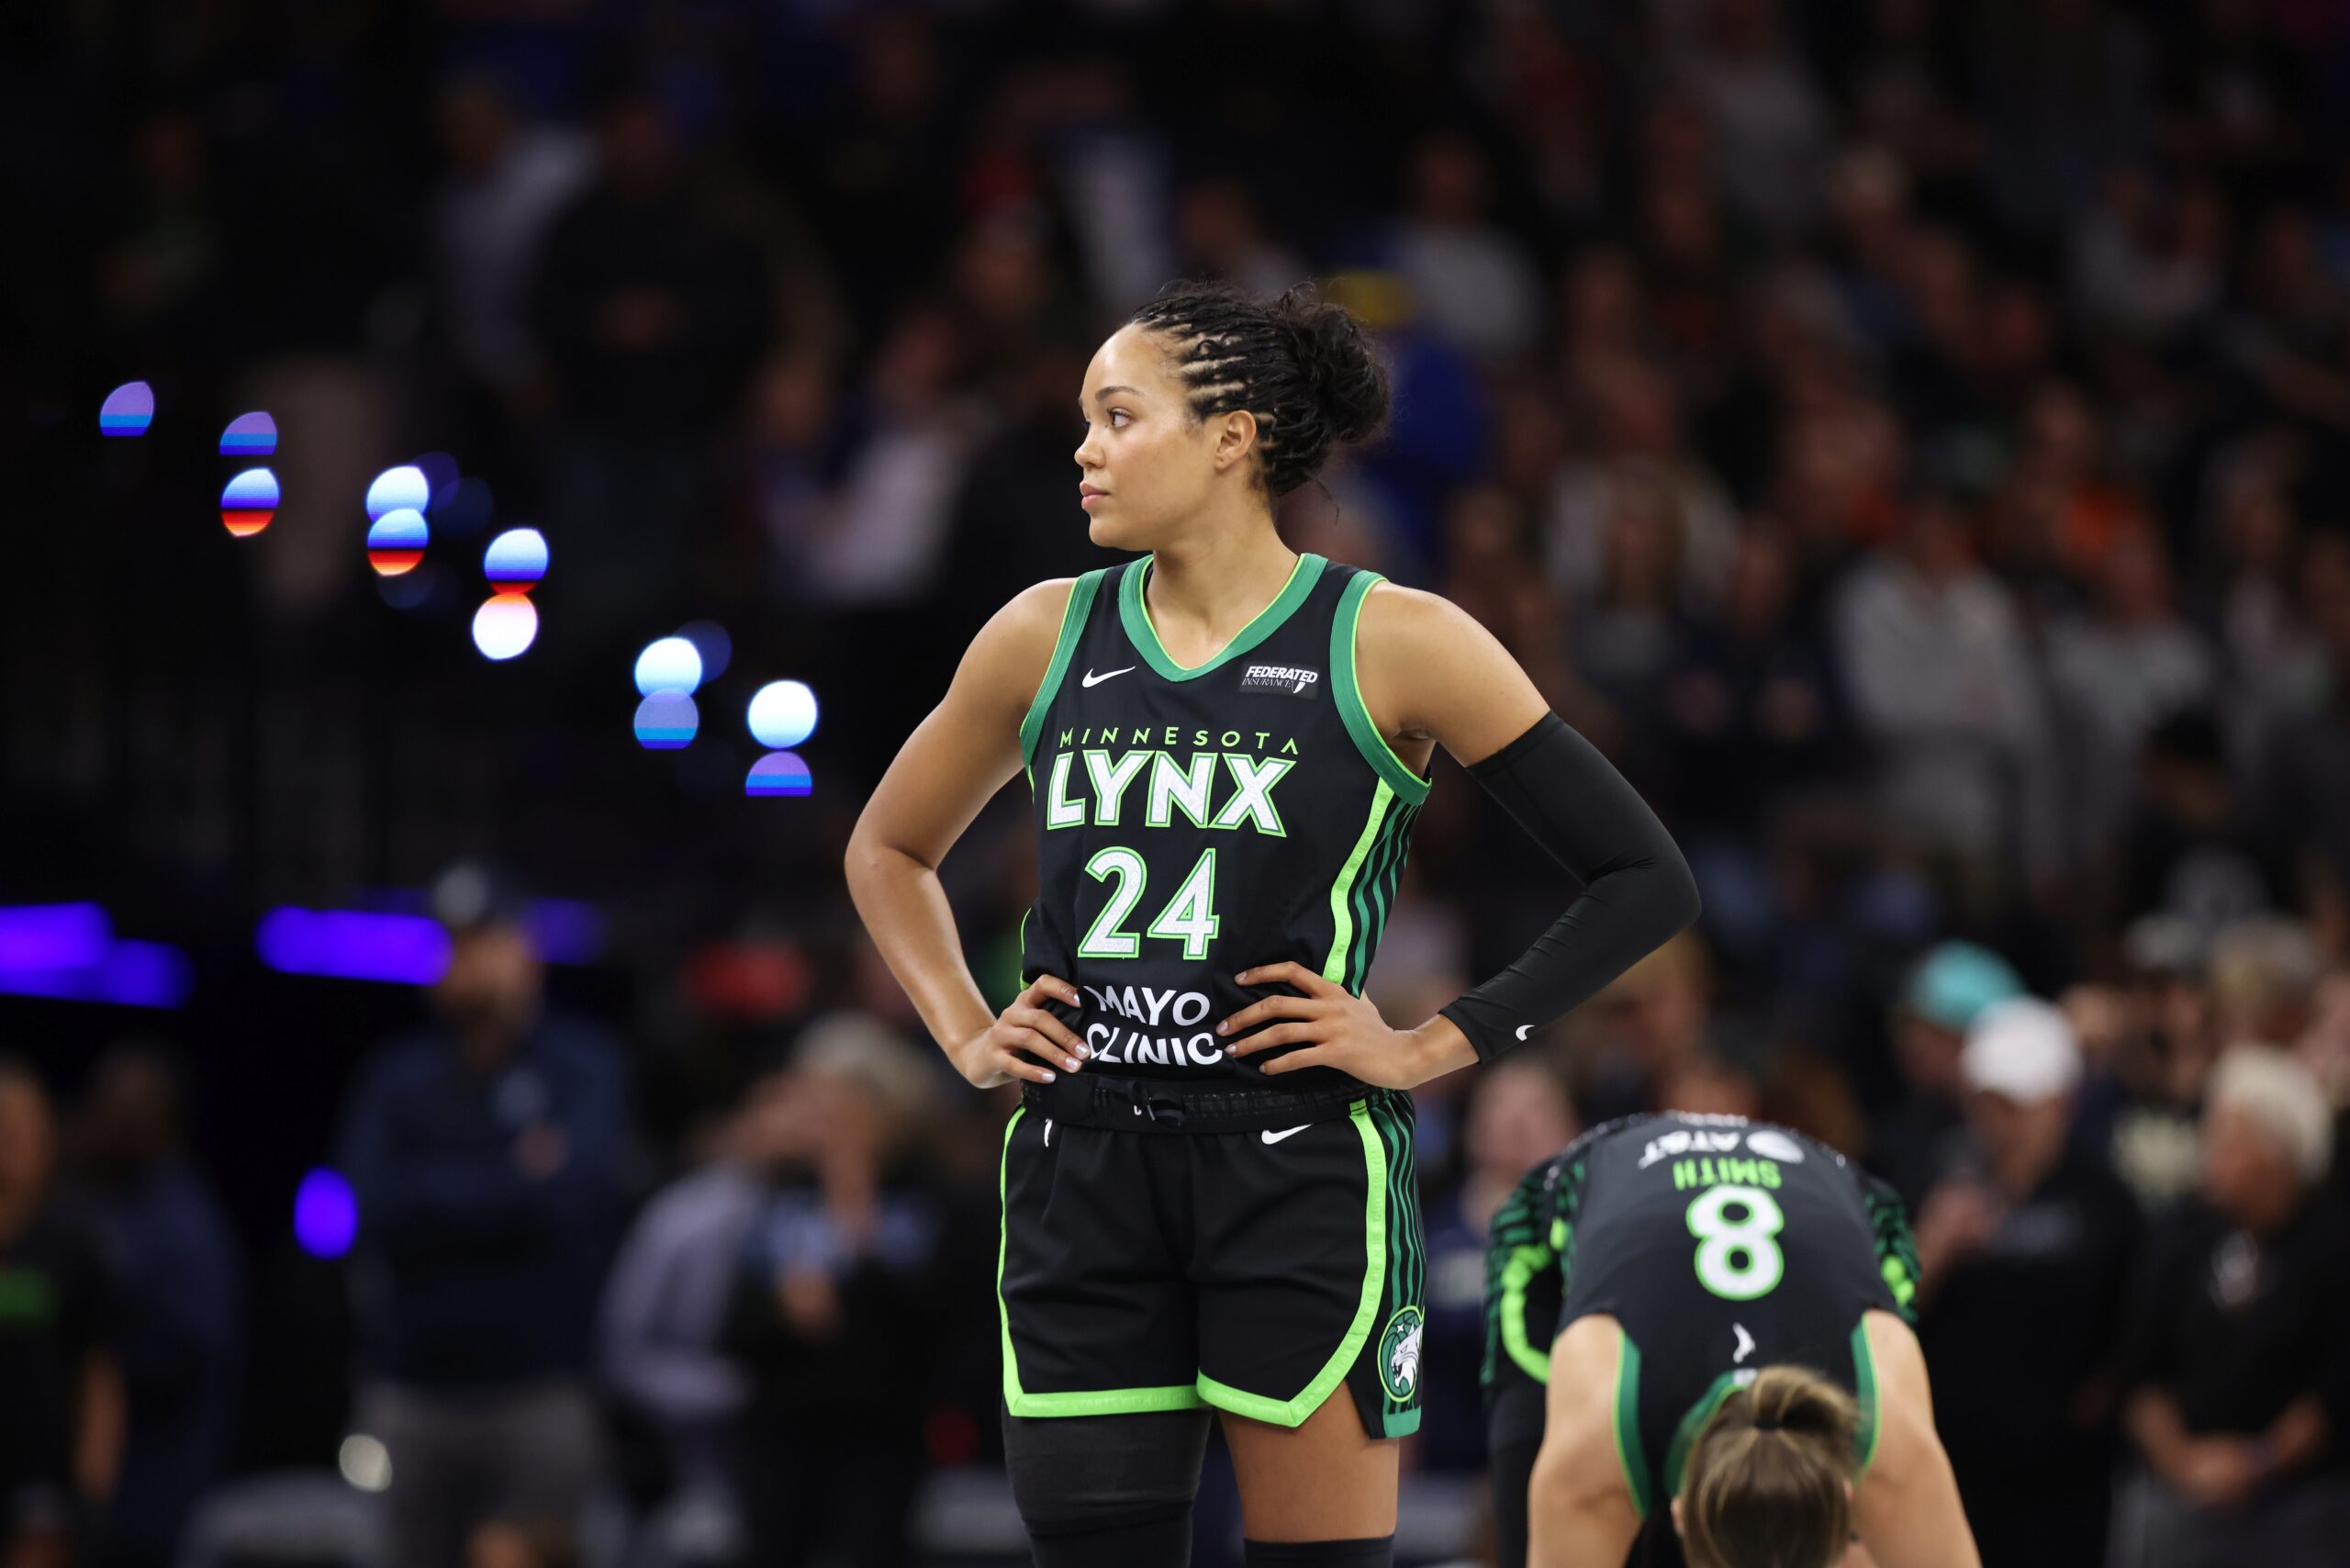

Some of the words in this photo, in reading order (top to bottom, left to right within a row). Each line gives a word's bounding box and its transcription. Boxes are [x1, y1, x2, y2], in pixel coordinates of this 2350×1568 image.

[1245, 666, 1318, 684] FEDERATED
[1059, 726, 1299, 755] MINNESOTA
[1046, 748, 1297, 838] LYNX
[1078, 846, 1220, 960] 24
[1083, 985, 1211, 1026] MAYO
[1086, 1023, 1223, 1067] CLINIC
[1673, 1157, 1783, 1191] SMITH
[1685, 1185, 1785, 1301] 8
